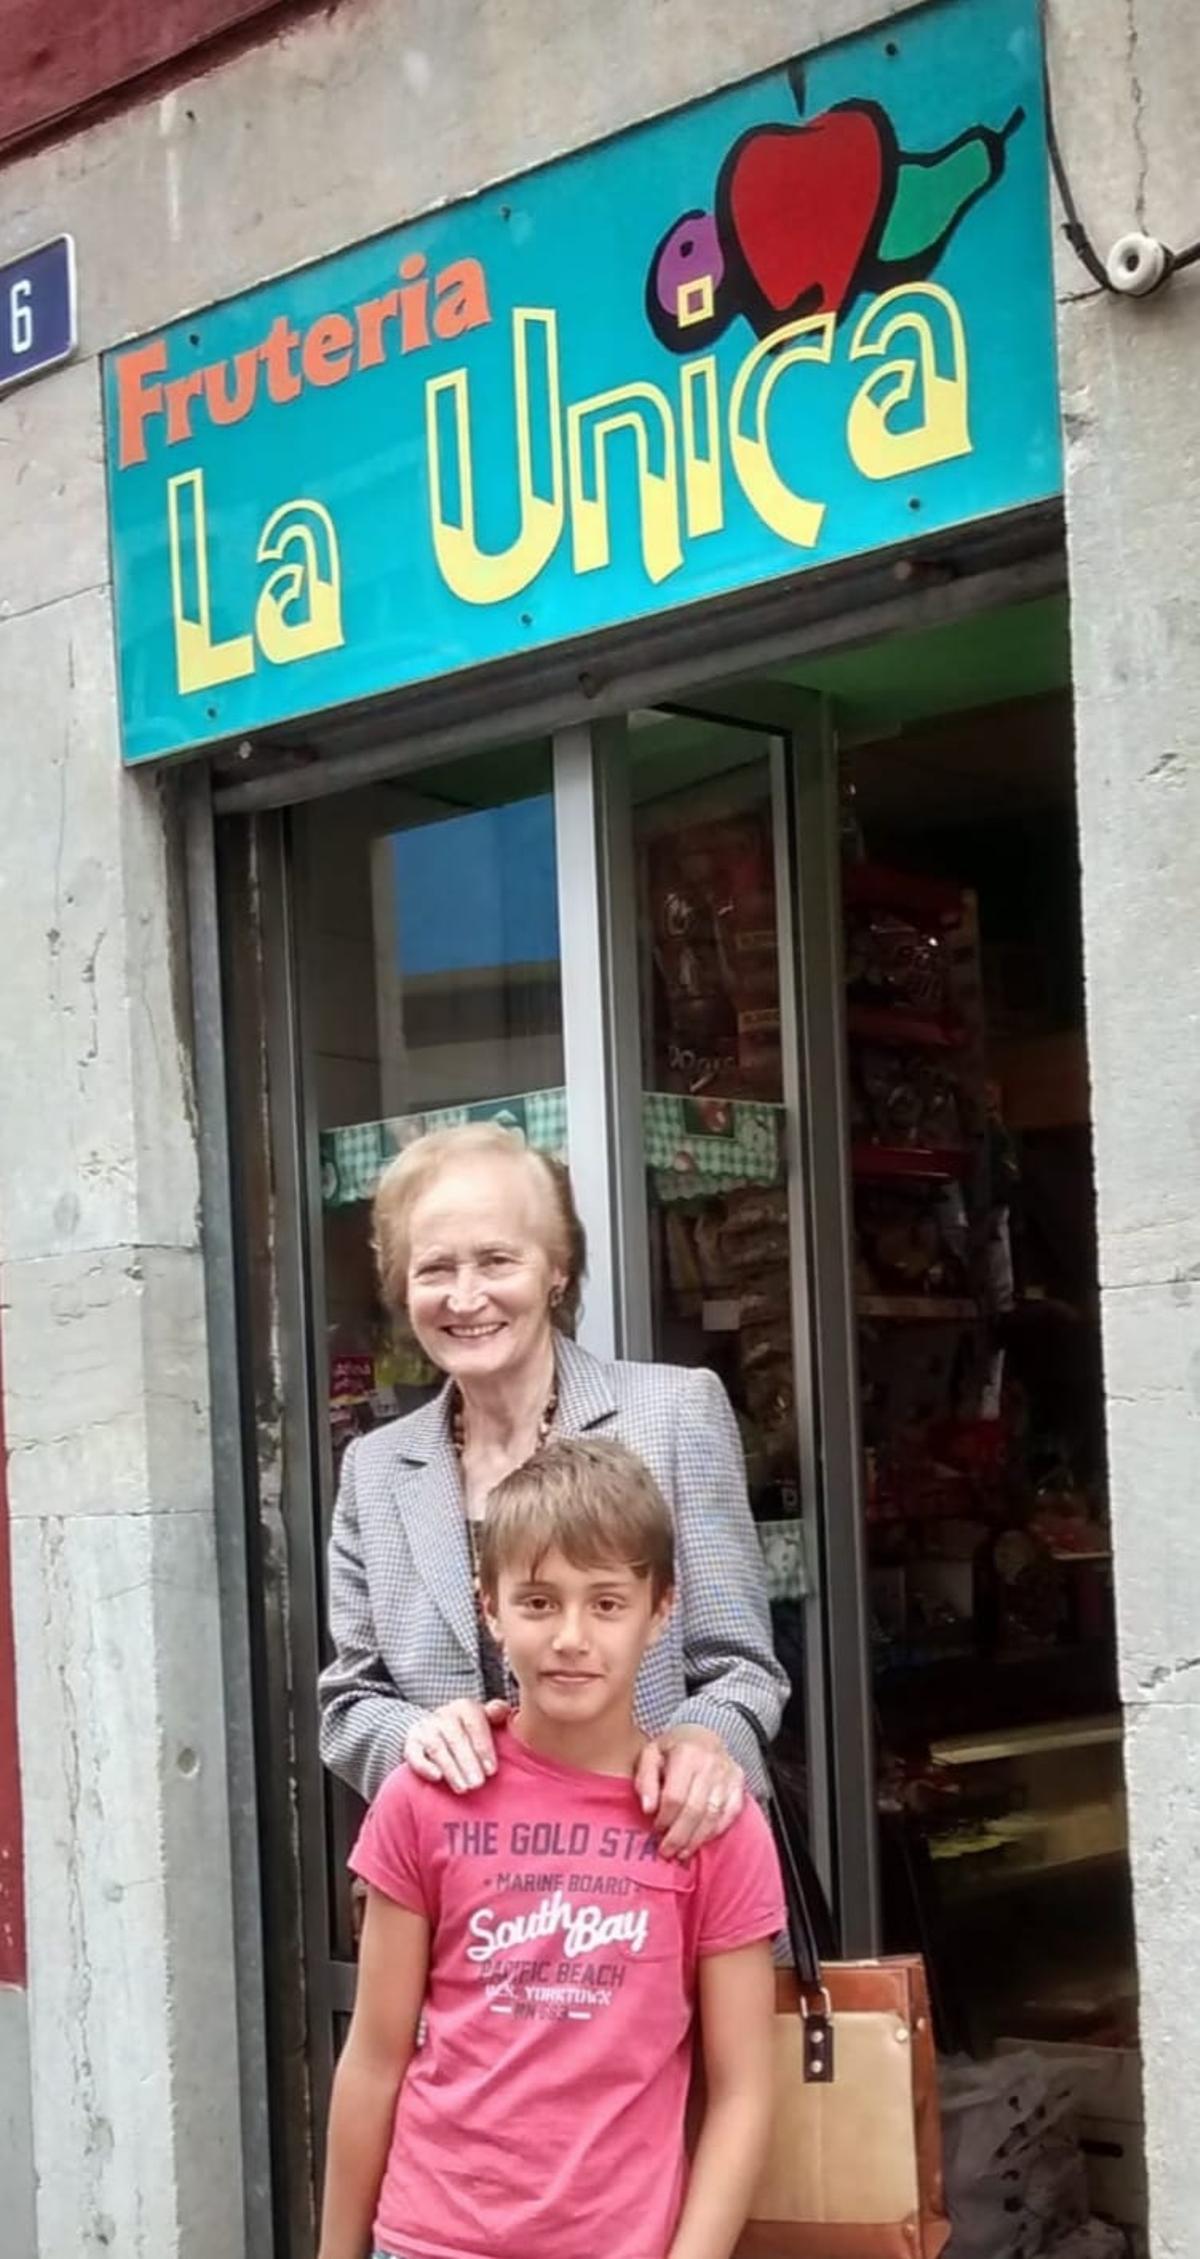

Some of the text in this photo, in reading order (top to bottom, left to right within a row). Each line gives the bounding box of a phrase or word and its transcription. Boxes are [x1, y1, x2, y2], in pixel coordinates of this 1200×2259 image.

[10, 279, 32, 354] 6
[115, 252, 491, 470] Fruteria
[167, 274, 974, 696] La Unica
[443, 1821, 666, 1862] THE GOLD STA
[497, 1872, 564, 1893] MARINE
[467, 1889, 648, 1962] South Bay
[556, 1962, 626, 1988] BEACH
